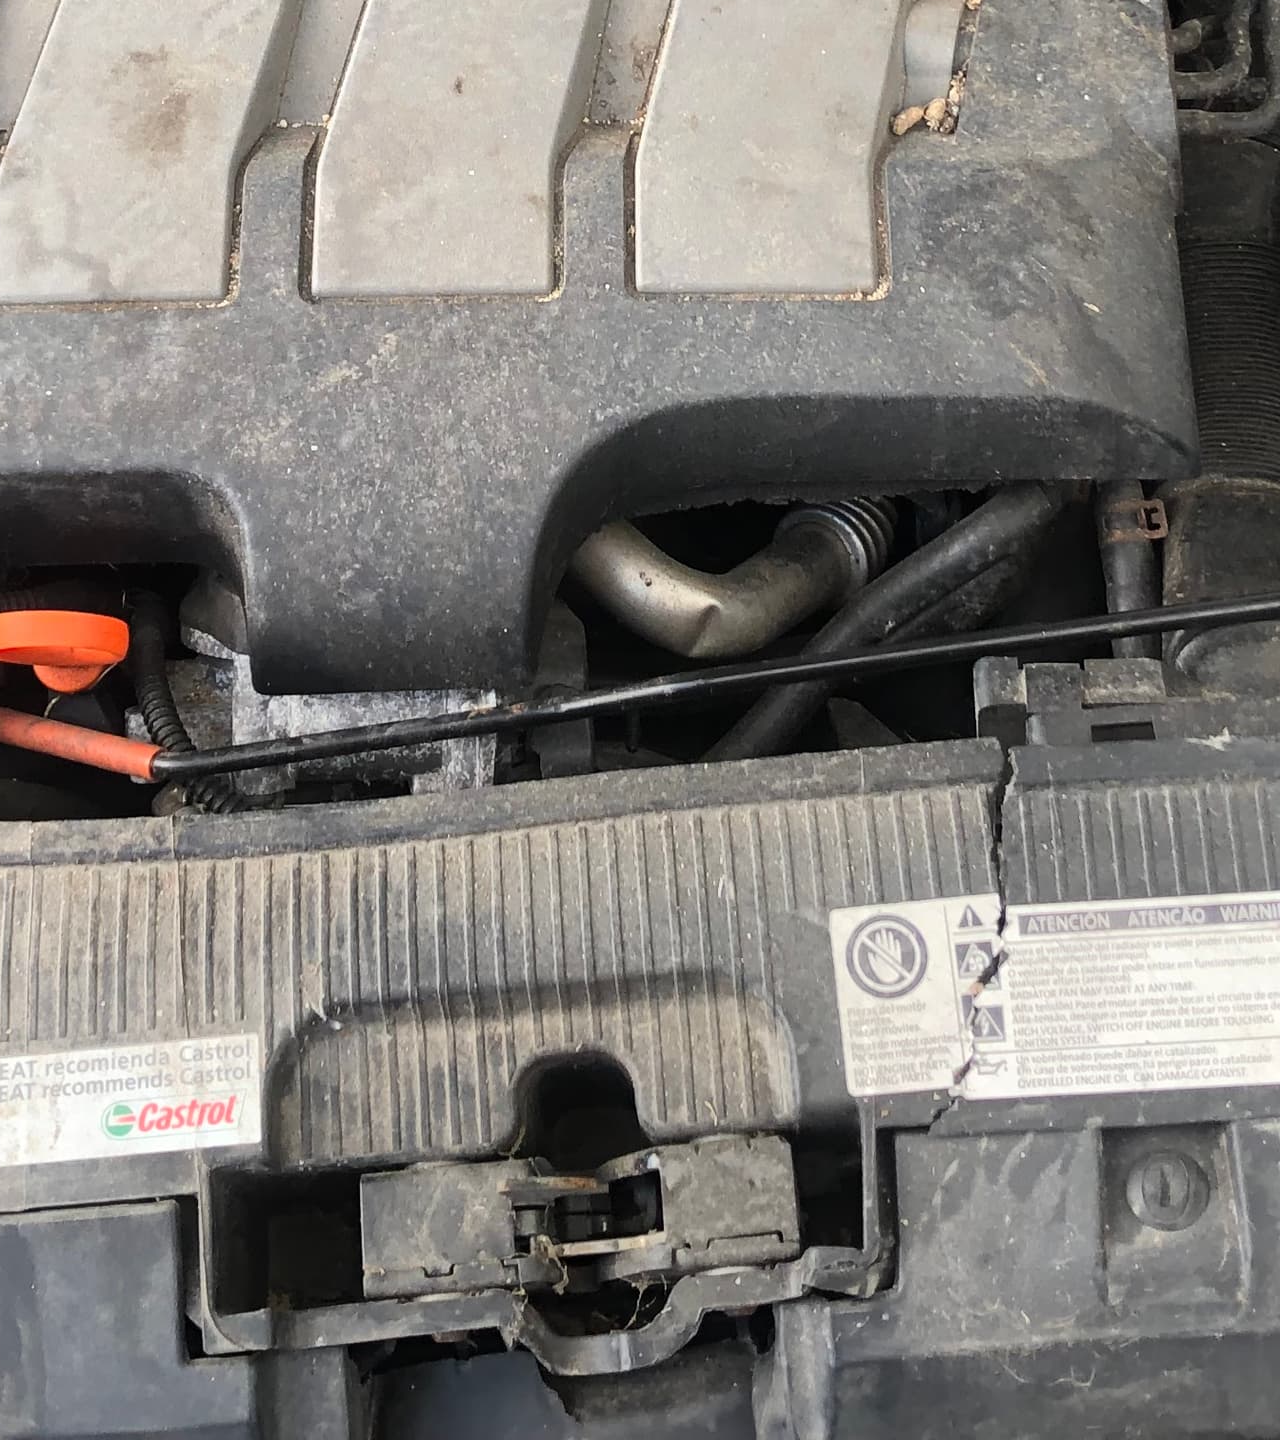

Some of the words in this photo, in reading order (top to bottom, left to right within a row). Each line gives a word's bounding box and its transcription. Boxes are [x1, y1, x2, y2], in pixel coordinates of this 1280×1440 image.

[1059, 987, 1078, 998] FAN
[1148, 981, 1168, 992] ANY
[1252, 990, 1266, 999] de
[1118, 1007, 1148, 1018] motor
[1086, 1021, 1123, 1033] SWITCH
[1125, 1020, 1143, 1031] OFF
[1145, 1017, 1182, 1029] ENGINE
[1183, 1016, 1219, 1028] BEFORE
[1222, 1013, 1274, 1026] TOUCHING
[1014, 1036, 1057, 1049] IGNITION
[45, 1046, 170, 1076] recomienda
[179, 1039, 250, 1062] Castrol
[1093, 1049, 1124, 1060] puede
[42, 1068, 173, 1098] recommends
[179, 1061, 251, 1085] Castrol
[855, 1074, 899, 1088] MOVING
[1017, 1075, 1073, 1089] OVERFILLED
[1074, 1072, 1112, 1085] ENGINE
[1113, 1071, 1130, 1083] OIL
[1132, 1070, 1154, 1082] CAN
[1156, 1068, 1201, 1081] DAMAGE
[138, 1094, 237, 1132] Castrol
